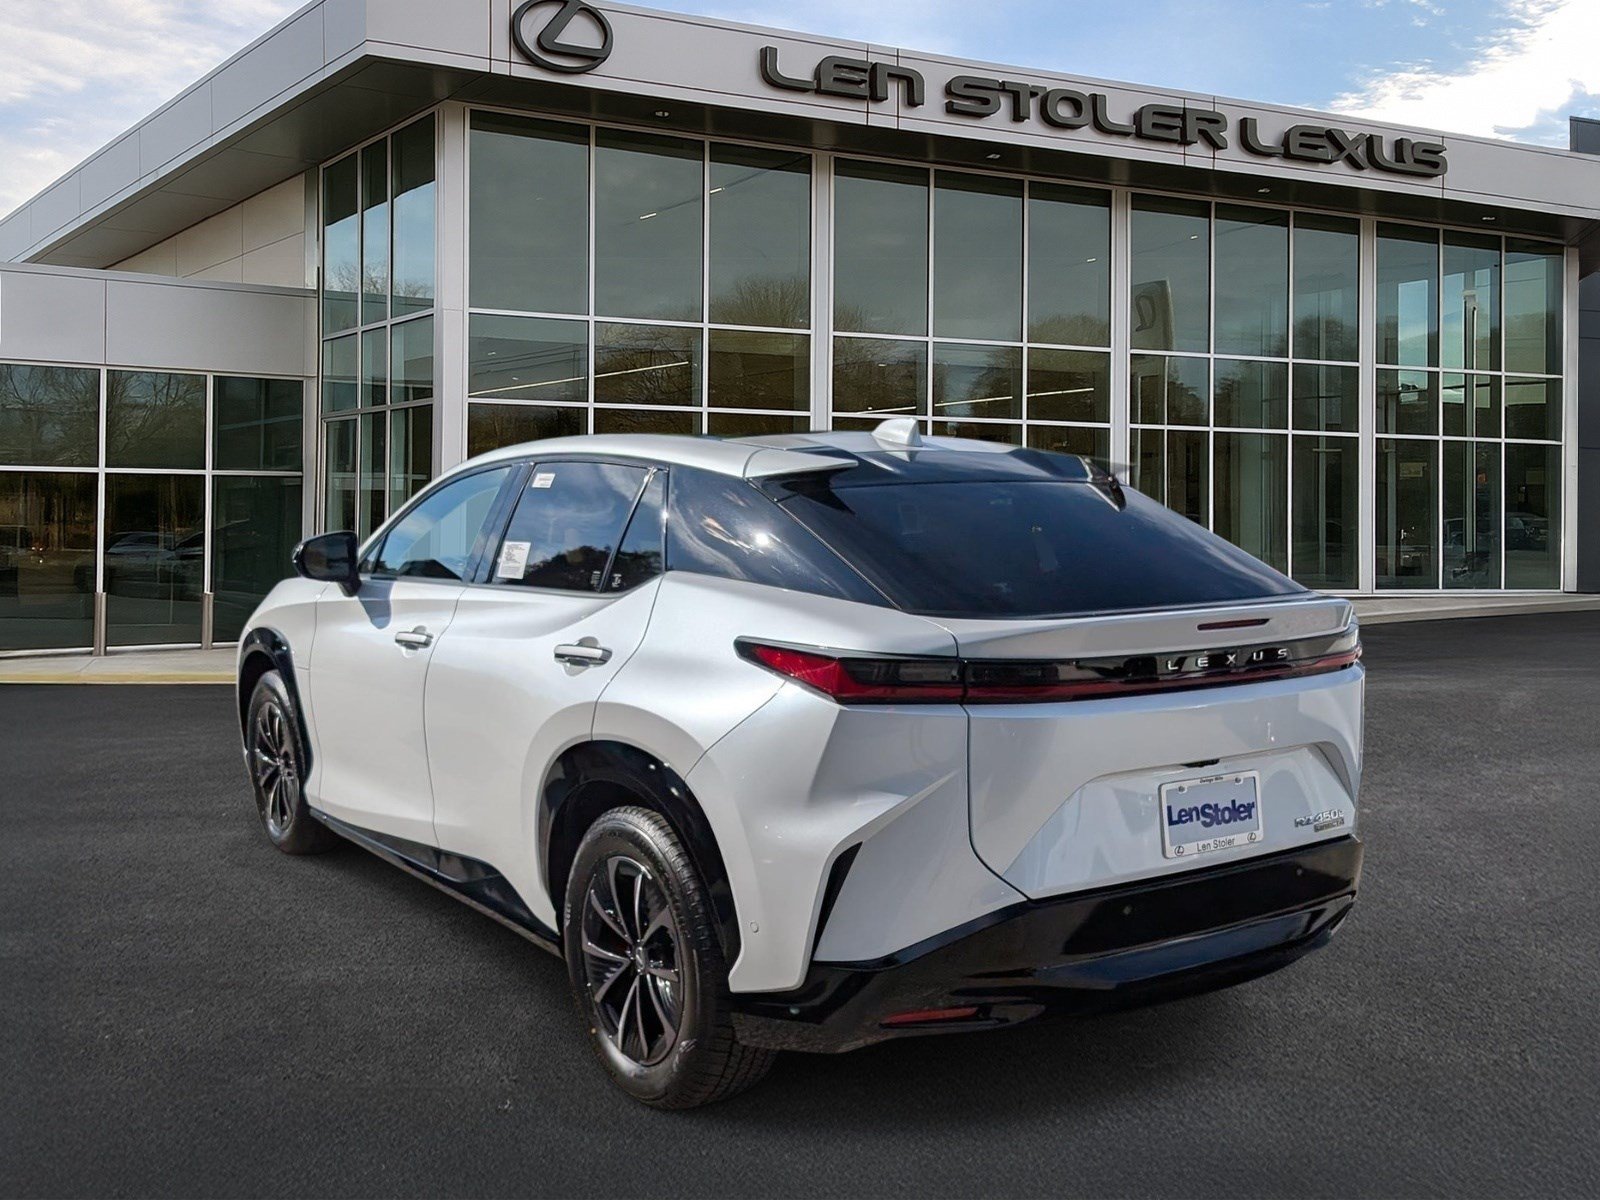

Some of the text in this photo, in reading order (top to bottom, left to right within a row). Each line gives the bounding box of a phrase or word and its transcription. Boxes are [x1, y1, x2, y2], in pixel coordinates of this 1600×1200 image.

[945, 75, 1227, 149] STOLER
[1239, 117, 1447, 177] LEXUS
[1168, 648, 1287, 670] LEXUS
[1196, 838, 1235, 852] Len Stoler
